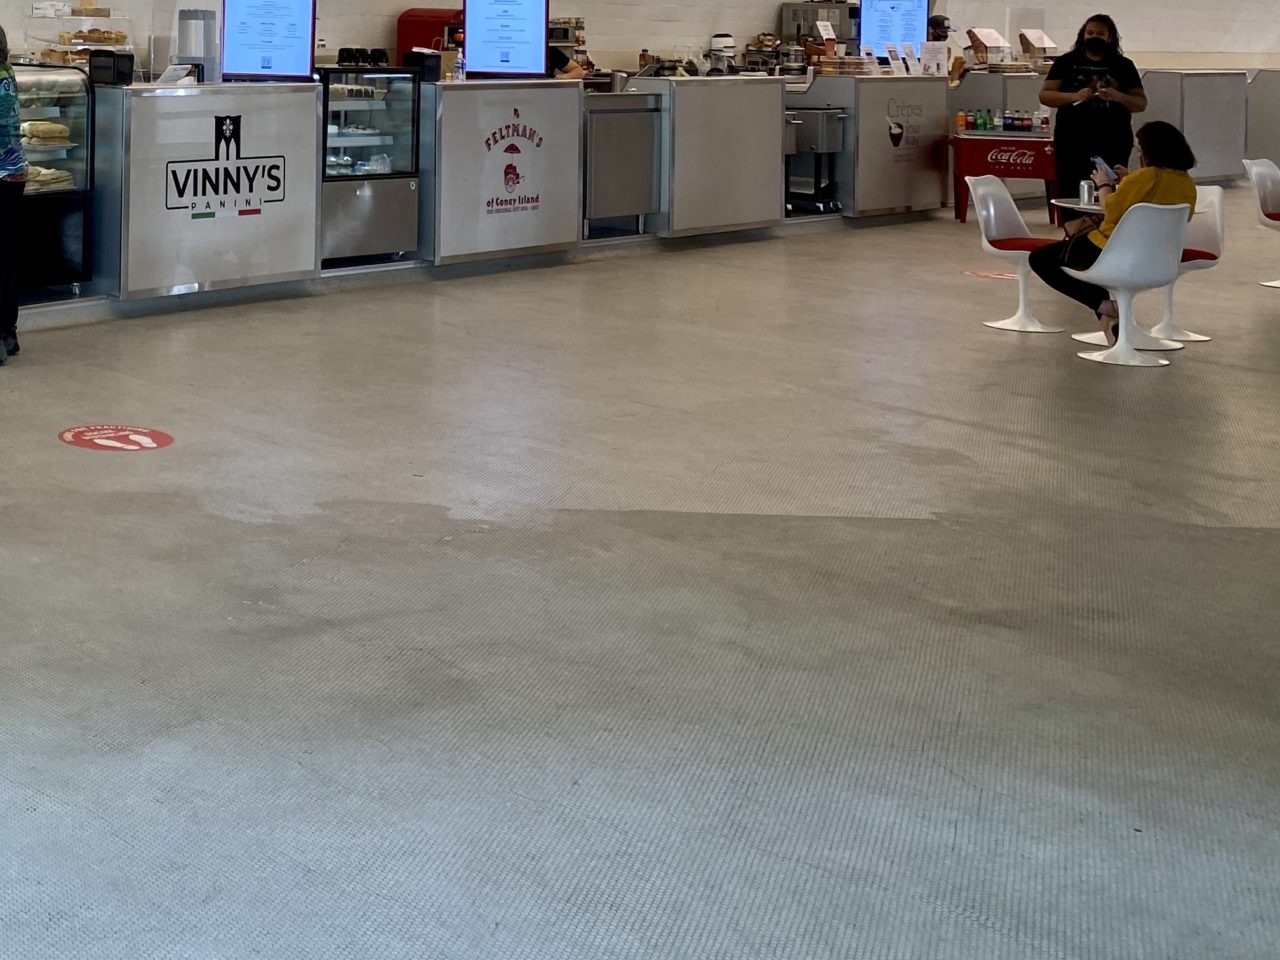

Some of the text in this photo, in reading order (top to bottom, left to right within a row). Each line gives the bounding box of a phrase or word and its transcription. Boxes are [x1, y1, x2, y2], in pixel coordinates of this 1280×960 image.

[484, 123, 543, 152] FELTMAN'S
[170, 164, 281, 198] VINNY'S
[191, 197, 262, 211] PANINI
[486, 194, 540, 208] of Coney Island
